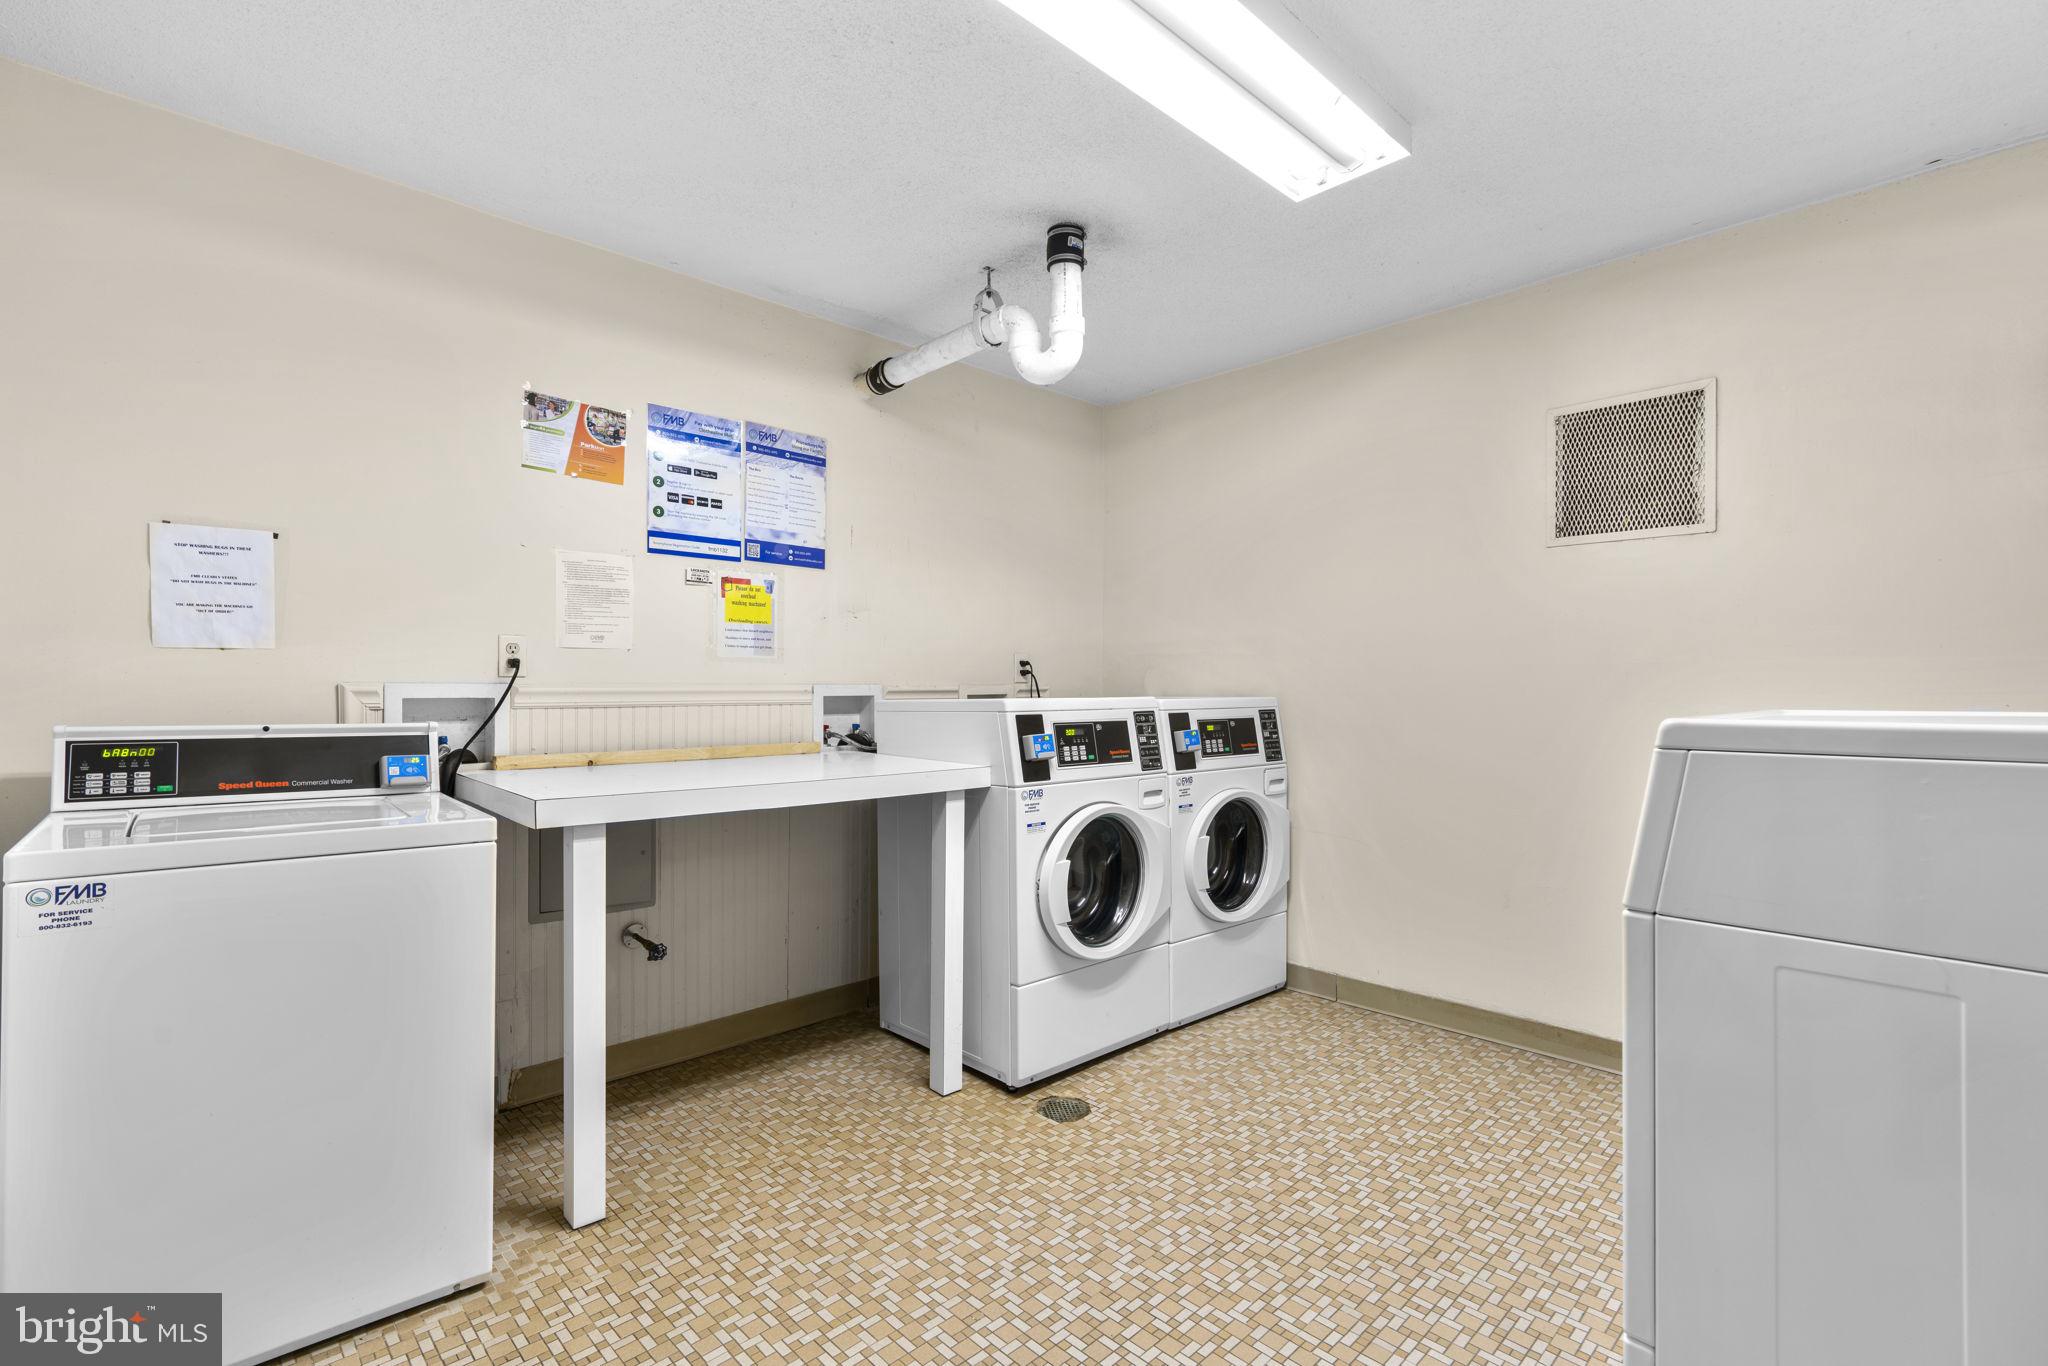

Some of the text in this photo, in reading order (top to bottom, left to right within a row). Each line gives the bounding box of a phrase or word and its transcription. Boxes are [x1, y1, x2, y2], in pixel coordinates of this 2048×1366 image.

[663, 414, 684, 426] FMB
[758, 430, 778, 442] FMB
[218, 780, 253, 790] Speed
[255, 780, 288, 788] Queen
[1028, 789, 1043, 800] FMB
[55, 883, 106, 905] FMB
[66, 898, 104, 906] LAUNDRY
[58, 908, 93, 916] SERVICE
[38, 921, 92, 930] 800-832-6193
